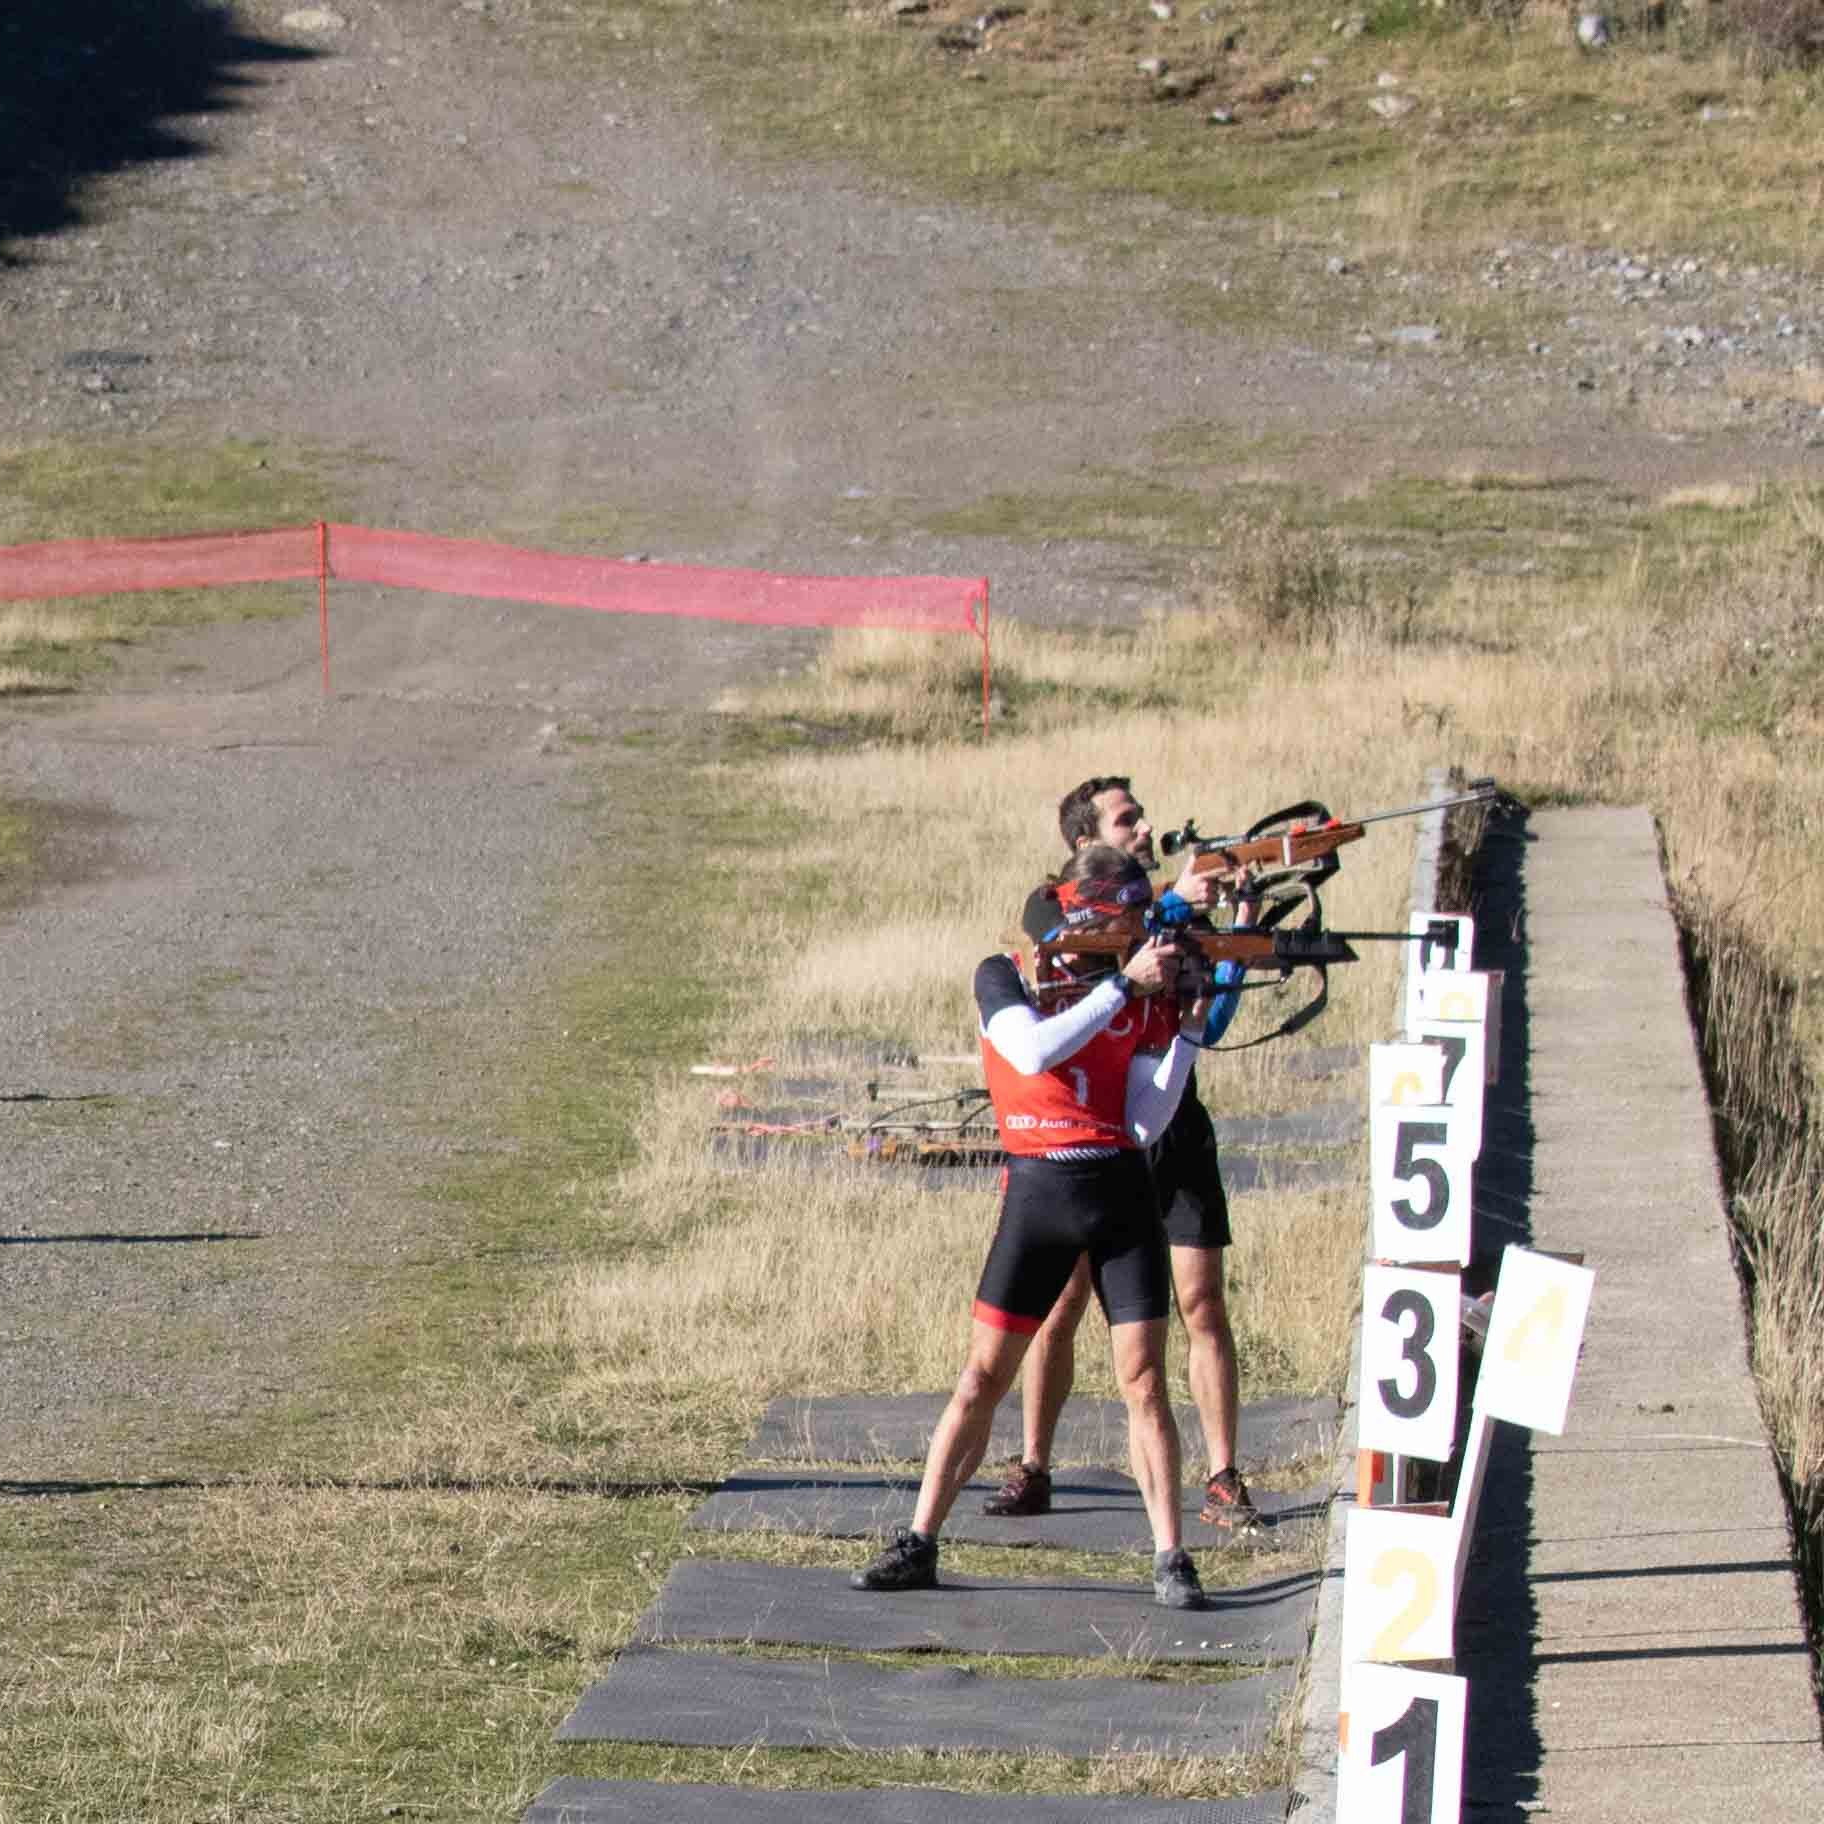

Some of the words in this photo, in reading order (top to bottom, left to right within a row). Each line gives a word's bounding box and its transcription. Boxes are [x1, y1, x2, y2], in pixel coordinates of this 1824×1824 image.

[1422, 1034, 1466, 1104] 7
[1390, 1121, 1450, 1231] 5
[1377, 1289, 1437, 1419] 3
[1366, 1547, 1440, 1660] 2
